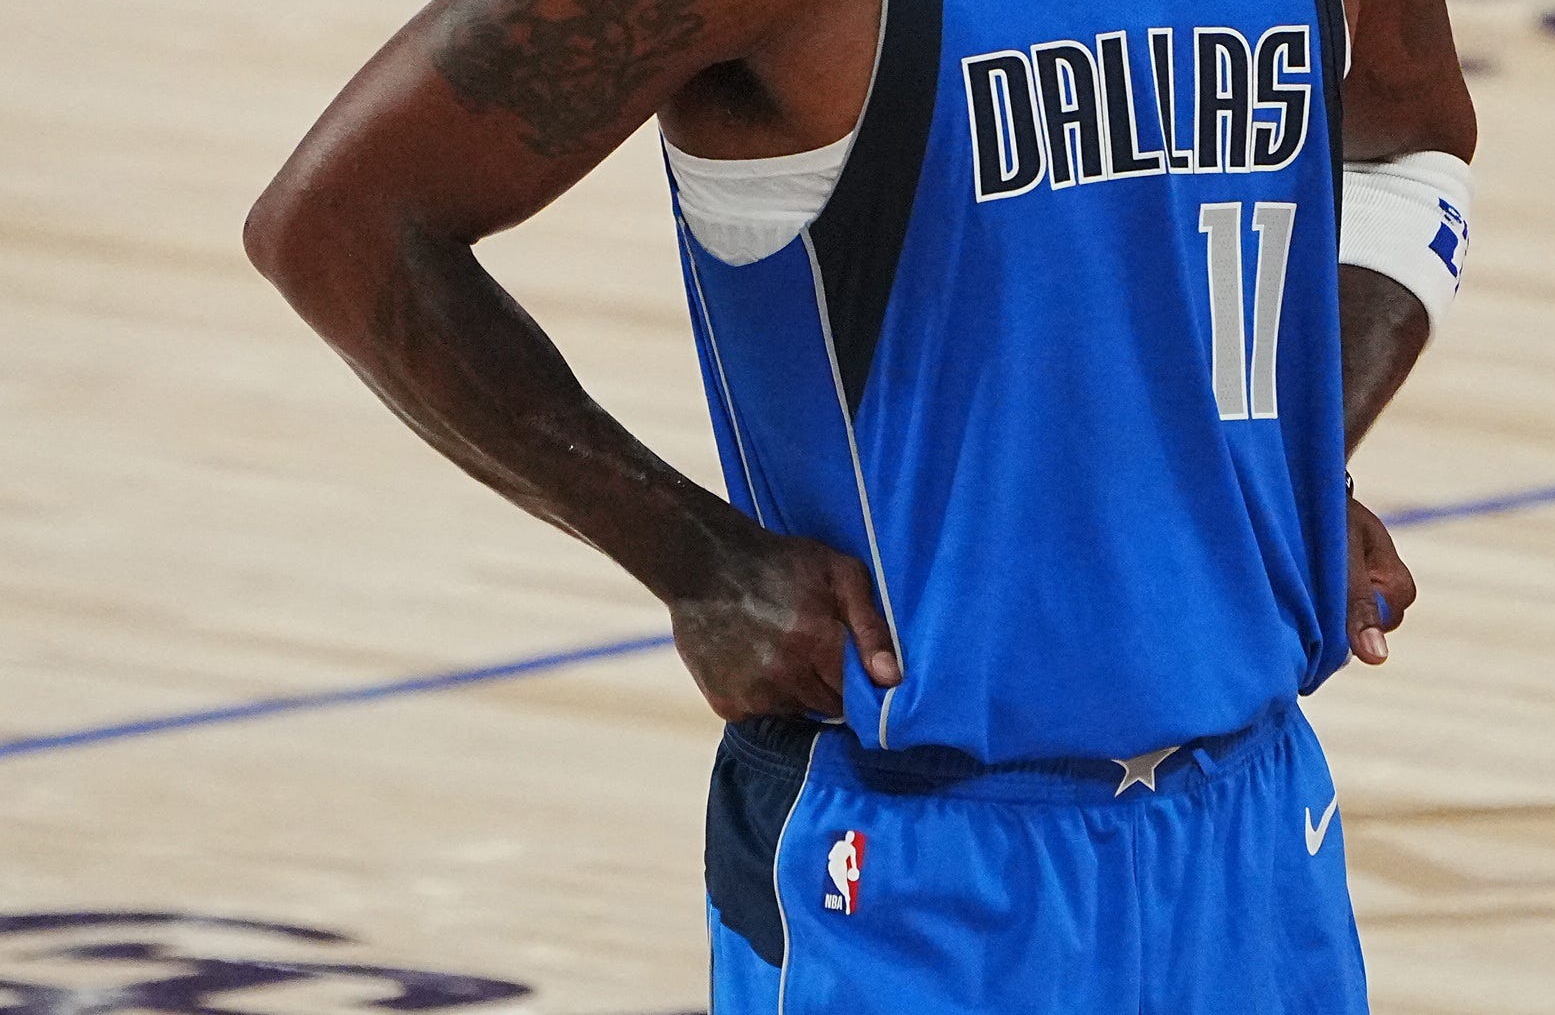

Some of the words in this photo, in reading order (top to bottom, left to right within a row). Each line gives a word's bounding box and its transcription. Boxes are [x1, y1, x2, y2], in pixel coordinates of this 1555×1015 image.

[962, 25, 1312, 203] DALLAS
[1199, 202, 1297, 420] 11
[824, 893, 843, 910] NBA
